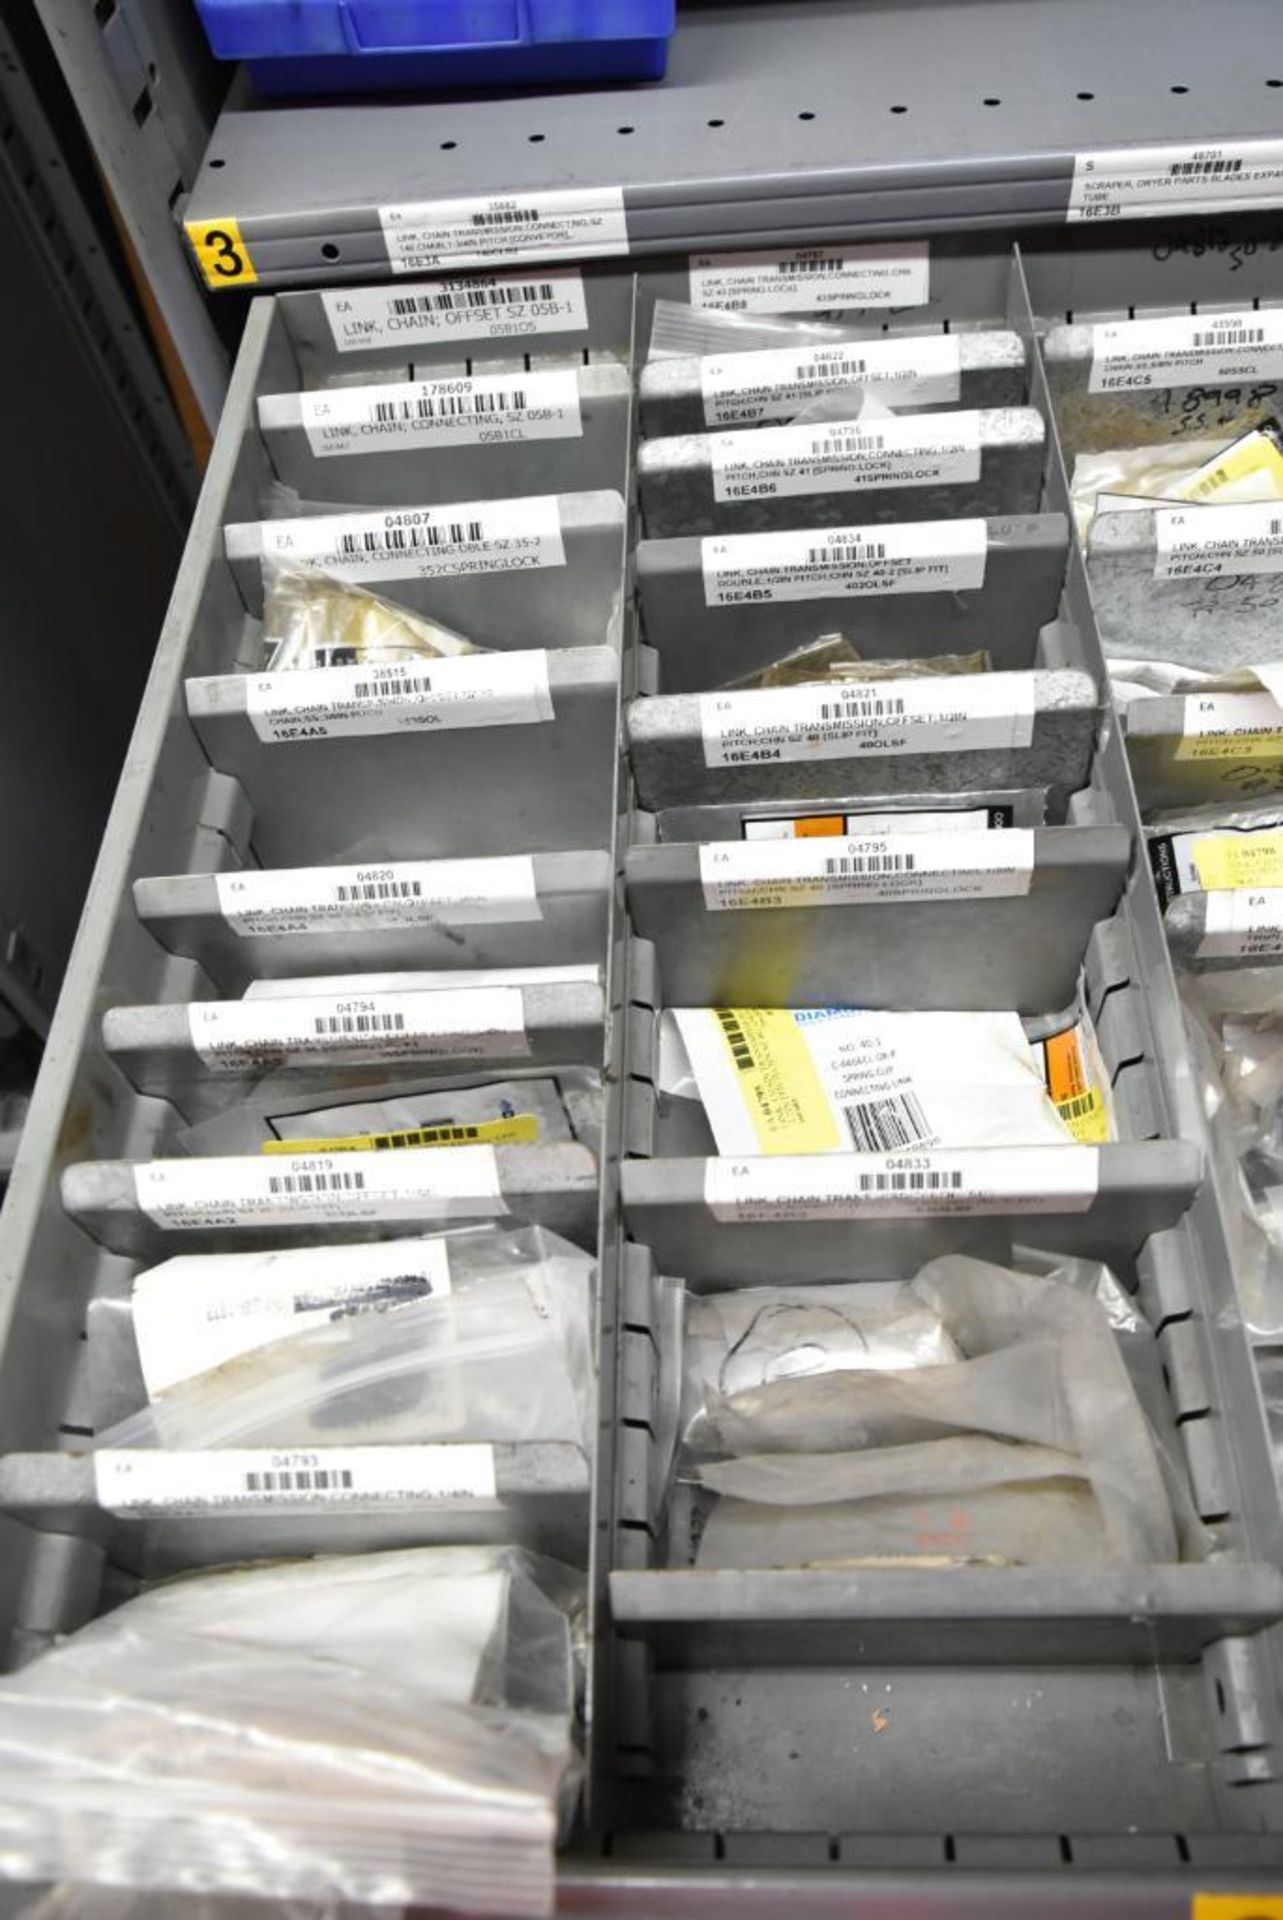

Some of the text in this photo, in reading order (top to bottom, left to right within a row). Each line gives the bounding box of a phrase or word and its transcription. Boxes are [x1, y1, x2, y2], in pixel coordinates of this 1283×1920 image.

[204, 229, 244, 277] 3
[337, 302, 352, 311] EA
[343, 322, 383, 336] LINK,
[387, 314, 441, 330] CHAIN;
[445, 309, 500, 324] OFFSET
[507, 306, 525, 317] SZ
[422, 382, 472, 396] 178609
[314, 405, 330, 415] EA
[322, 426, 356, 439] LINK,
[412, 414, 503, 431] CONNECTING,
[506, 411, 523, 422] SZ
[725, 483, 777, 496] 16E4B6
[385, 513, 430, 527] 04807
[1204, 540, 1239, 550] CHAIN
[718, 589, 773, 603] 16E4B5
[721, 749, 781, 762] 16E4B4
[847, 842, 887, 854] 04795
[885, 1159, 931, 1171] 04833
